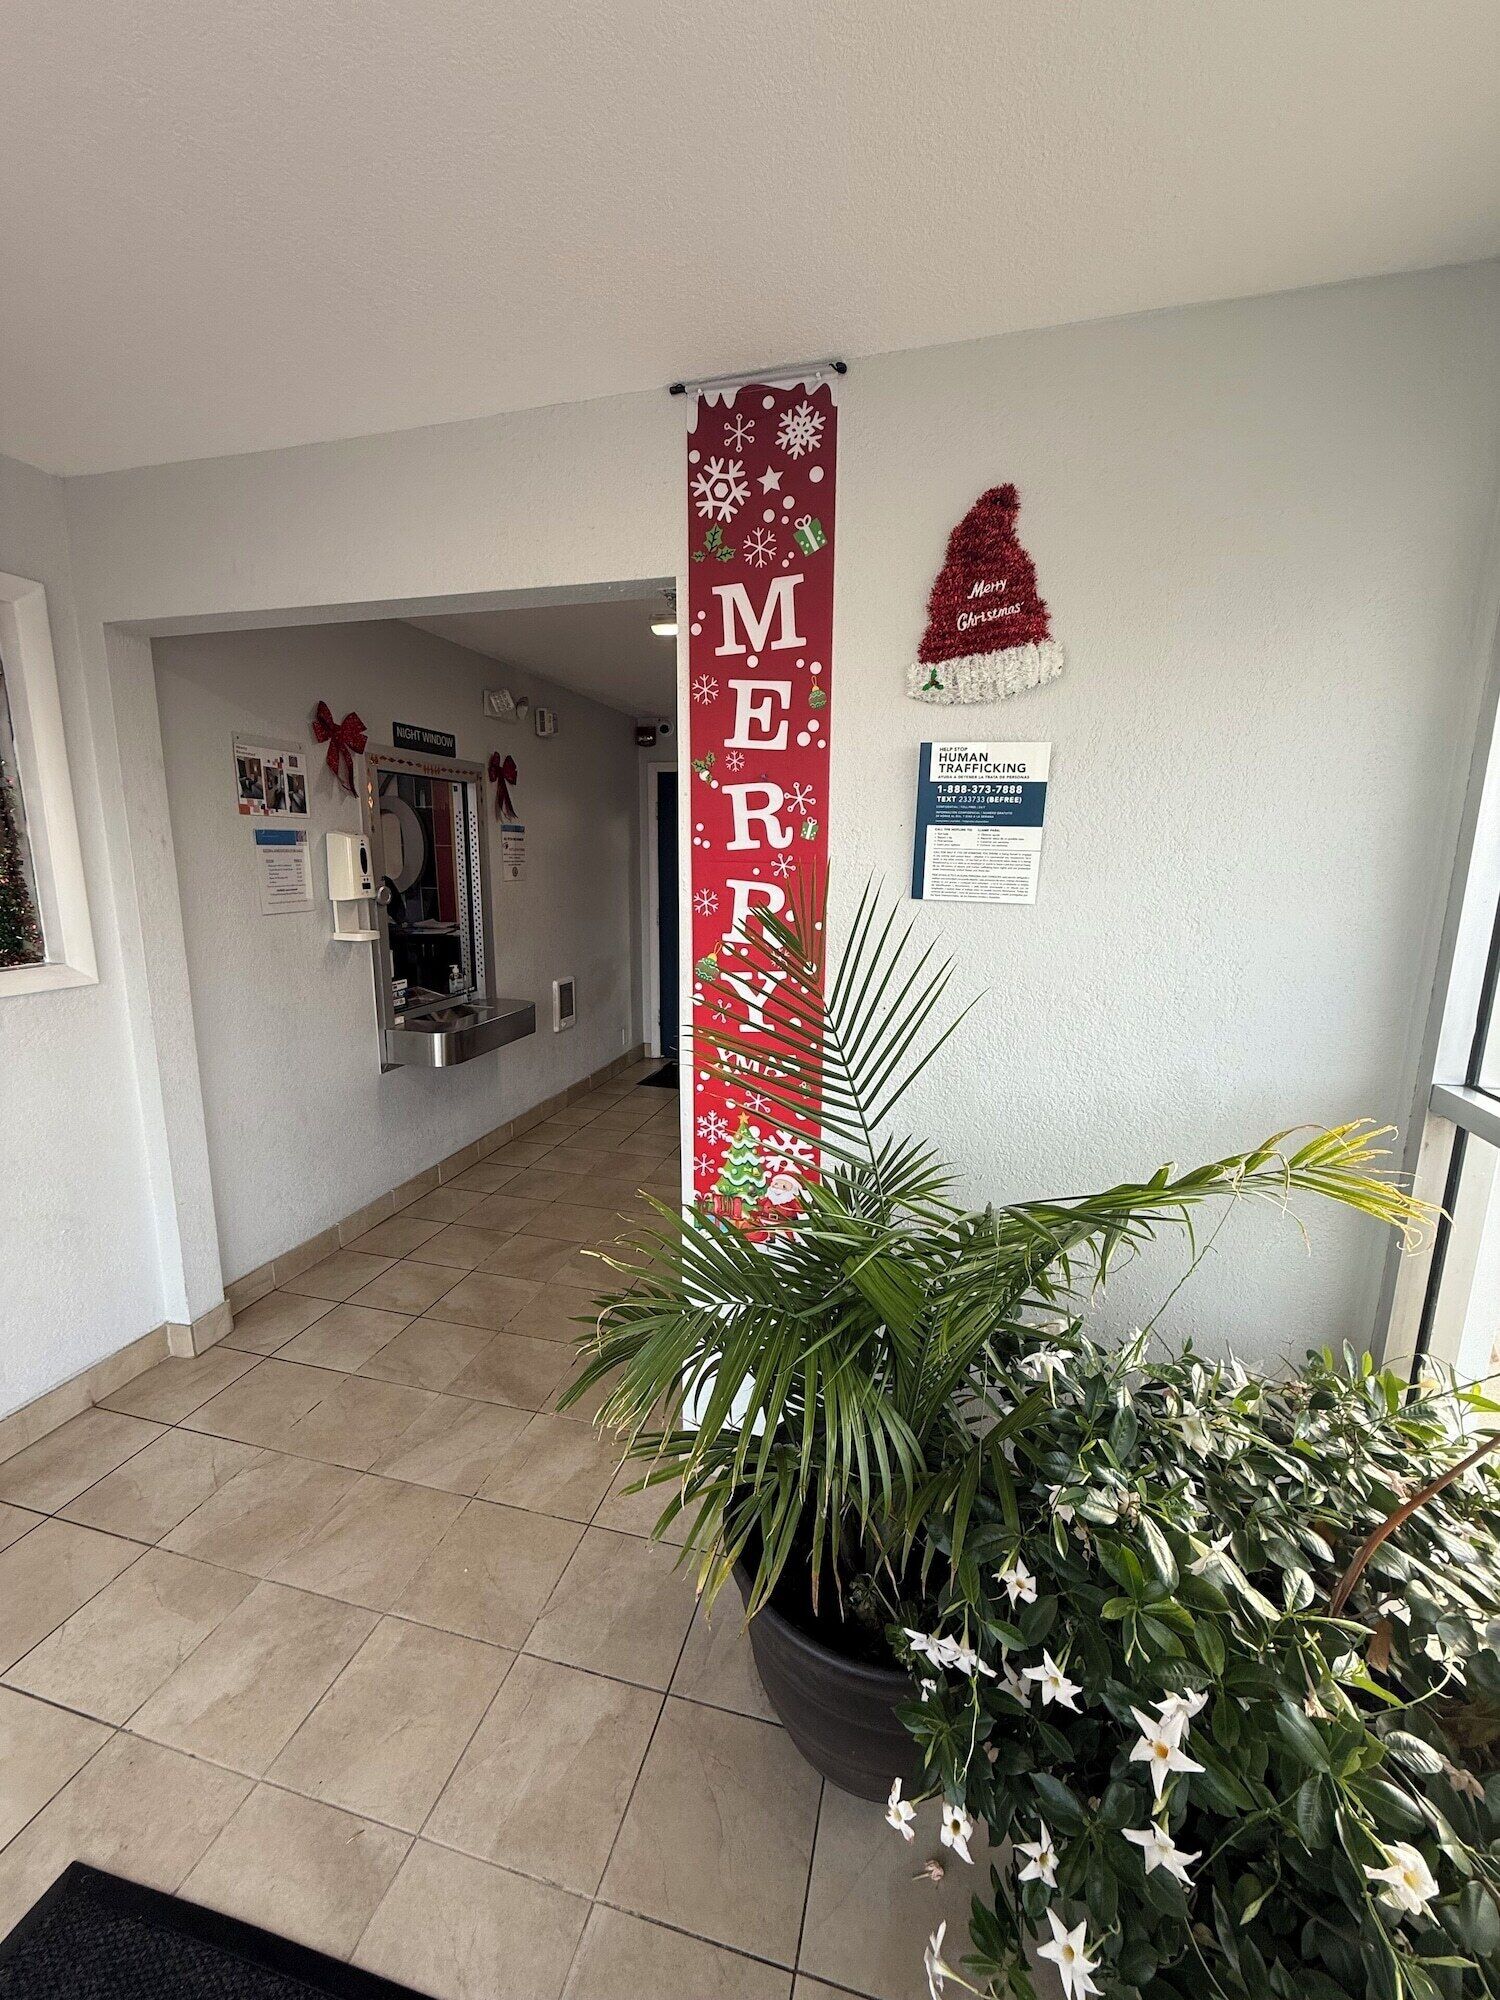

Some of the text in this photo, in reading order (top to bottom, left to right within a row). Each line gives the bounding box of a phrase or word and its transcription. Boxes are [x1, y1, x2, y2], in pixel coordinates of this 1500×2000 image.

[967, 579, 1007, 599] Merry
[957, 601, 1024, 631] Christmas
[396, 726, 454, 747] NIGHT WINDOW
[939, 753, 988, 762] HUMAN
[939, 763, 1026, 773] TRAFFICKING
[937, 784, 1023, 794] 1-888-373-7888
[711, 573, 808, 1033] MERRY
[936, 795, 956, 803] TEXT
[986, 796, 1022, 804] (BEFREE)
